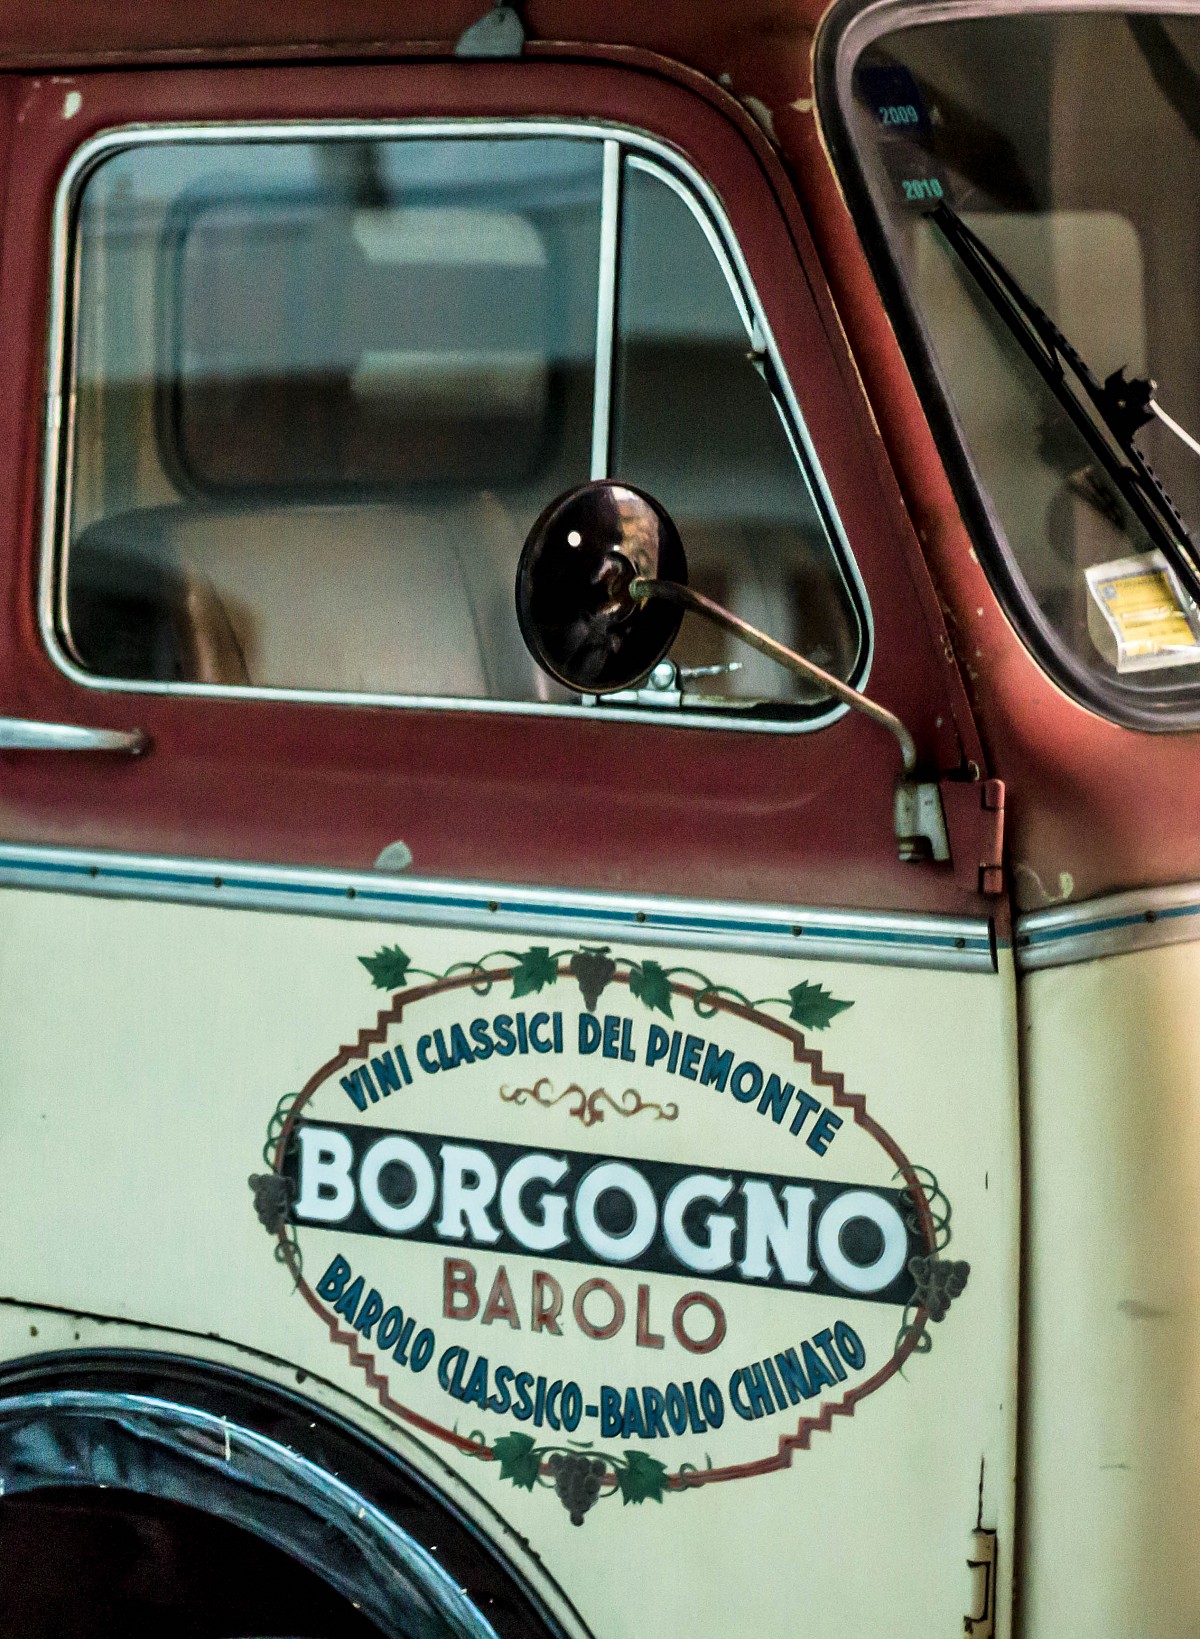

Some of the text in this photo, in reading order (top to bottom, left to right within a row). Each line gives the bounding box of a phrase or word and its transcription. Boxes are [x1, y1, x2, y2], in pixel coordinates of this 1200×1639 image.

[879, 104, 919, 125] 2009
[902, 178, 944, 200] 2010
[339, 1011, 844, 1157] VINI CLASSICI DEL PIEMONTE
[297, 1125, 909, 1294] BORGOGNO
[315, 1253, 435, 1373] BAROLO
[729, 1320, 866, 1420] CHINATO
[442, 1257, 727, 1355] BAROLO
